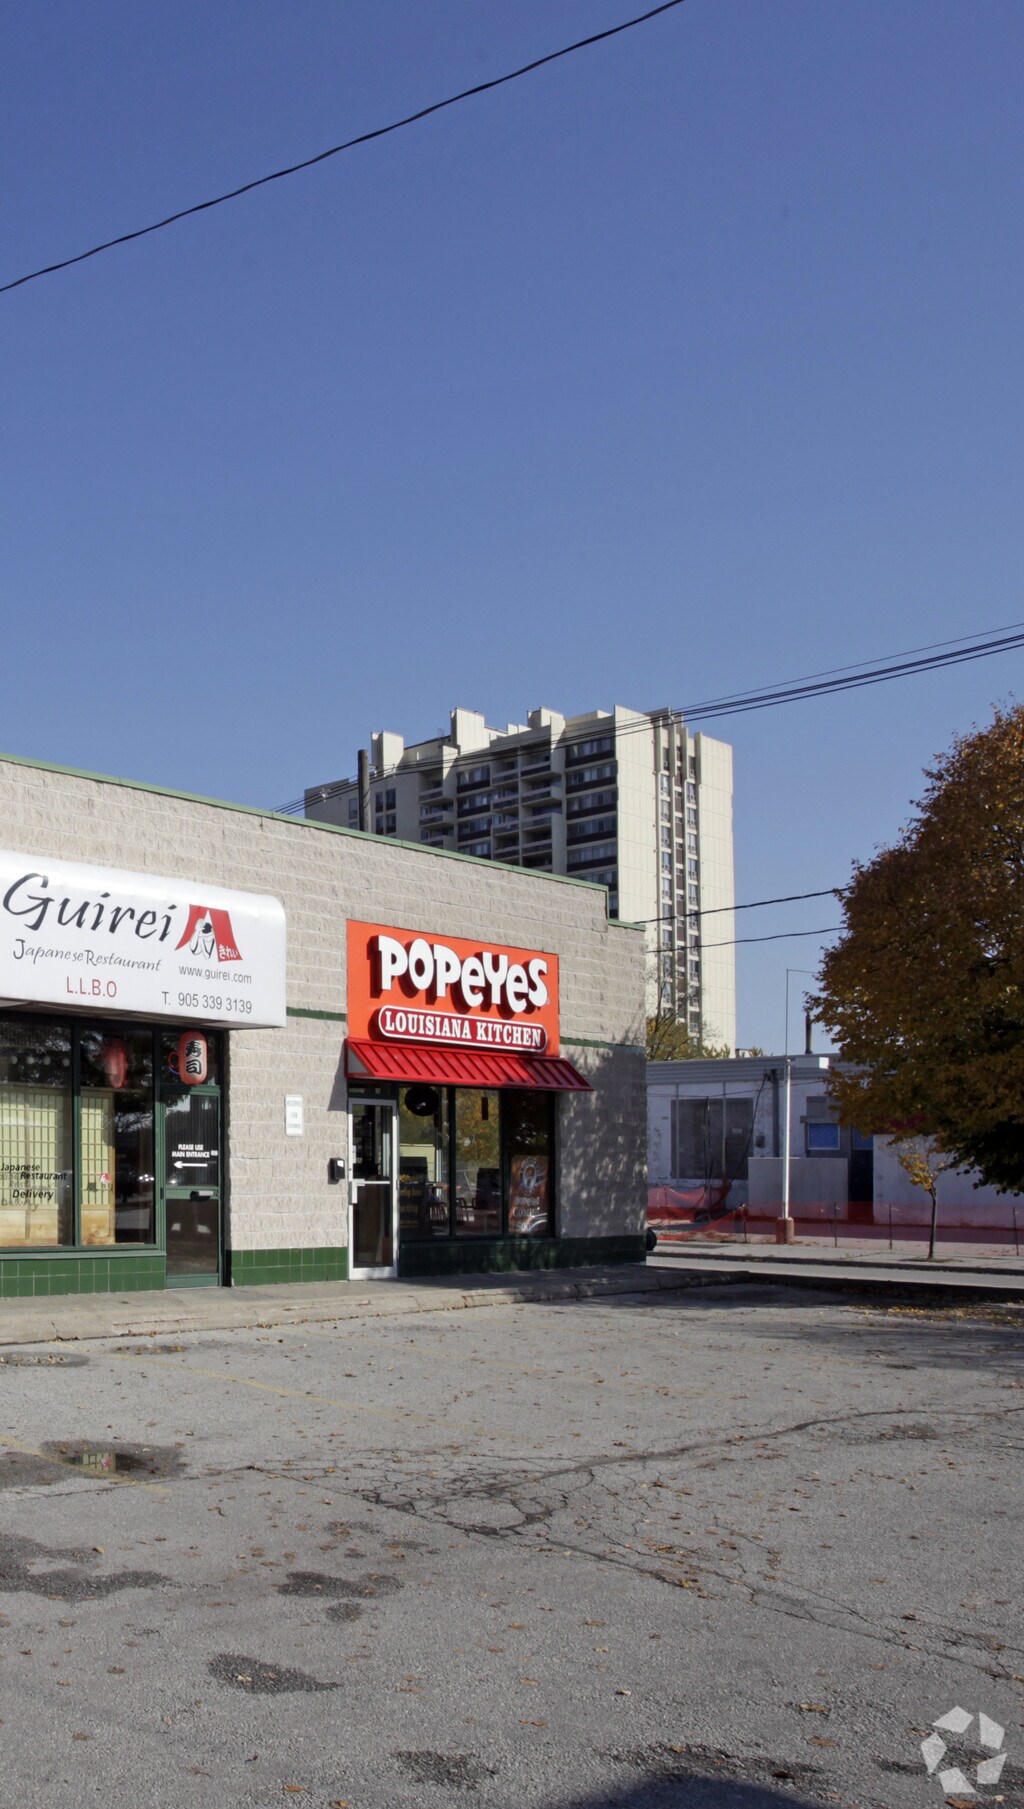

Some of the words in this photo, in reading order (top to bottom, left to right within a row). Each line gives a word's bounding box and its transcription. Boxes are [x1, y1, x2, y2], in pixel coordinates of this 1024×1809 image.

[3, 872, 177, 942] Guirei
[178, 965, 252, 985] www.guirei.com
[66, 976, 117, 998] L.L.B.O
[162, 991, 172, 1006] T.
[178, 992, 199, 1008] 905
[202, 994, 223, 1010] 339
[225, 996, 252, 1014] 3139
[385, 1011, 472, 1040] LOUISIANA
[476, 1021, 542, 1047] KITCHEN
[171, 1150, 185, 1158] MAIN
[177, 1143, 194, 1151] PLEASE
[1, 1162, 41, 1174] Japanese
[20, 1171, 67, 1180] Restaurant
[12, 1189, 54, 1201] Delivery
